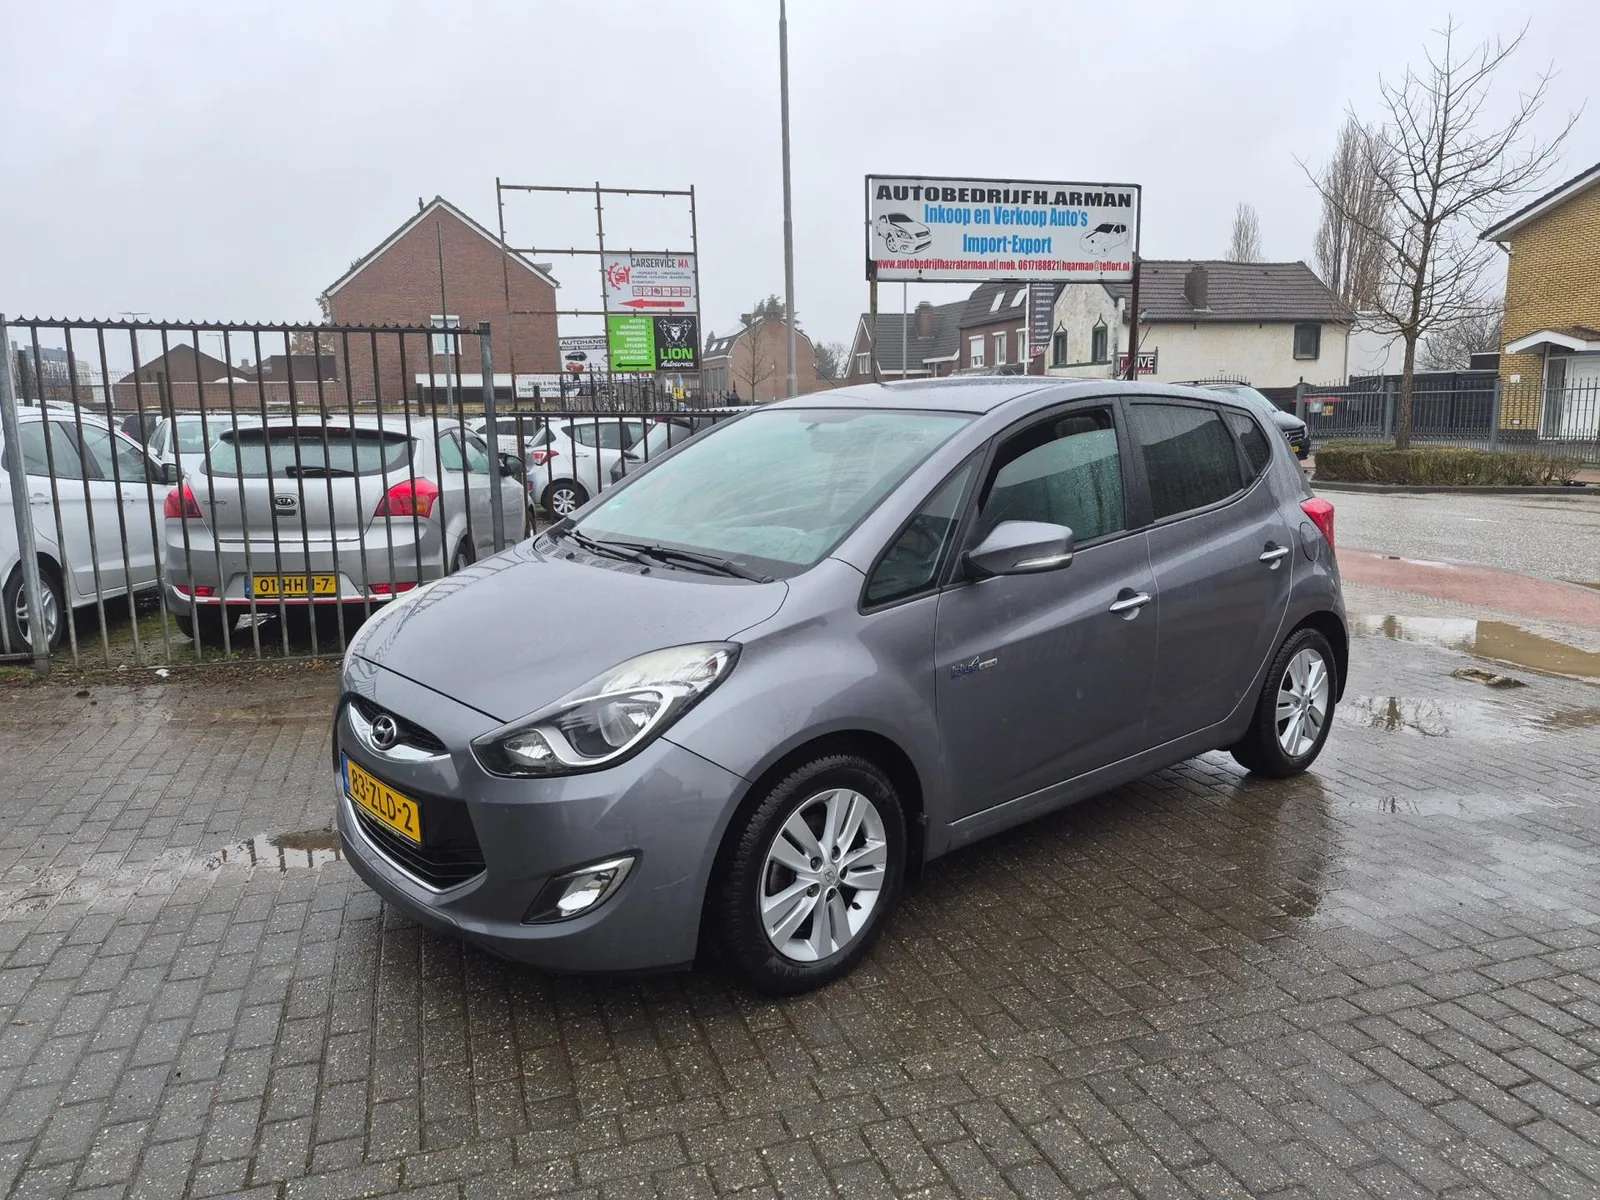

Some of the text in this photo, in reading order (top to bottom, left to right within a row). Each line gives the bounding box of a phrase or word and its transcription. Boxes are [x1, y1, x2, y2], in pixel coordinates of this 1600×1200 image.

[924, 203, 1088, 228] Inkoop en Verkoop Auto's
[963, 233, 1052, 256] Import-Export
[630, 257, 676, 269] CARSERVICE
[660, 347, 694, 360] LION
